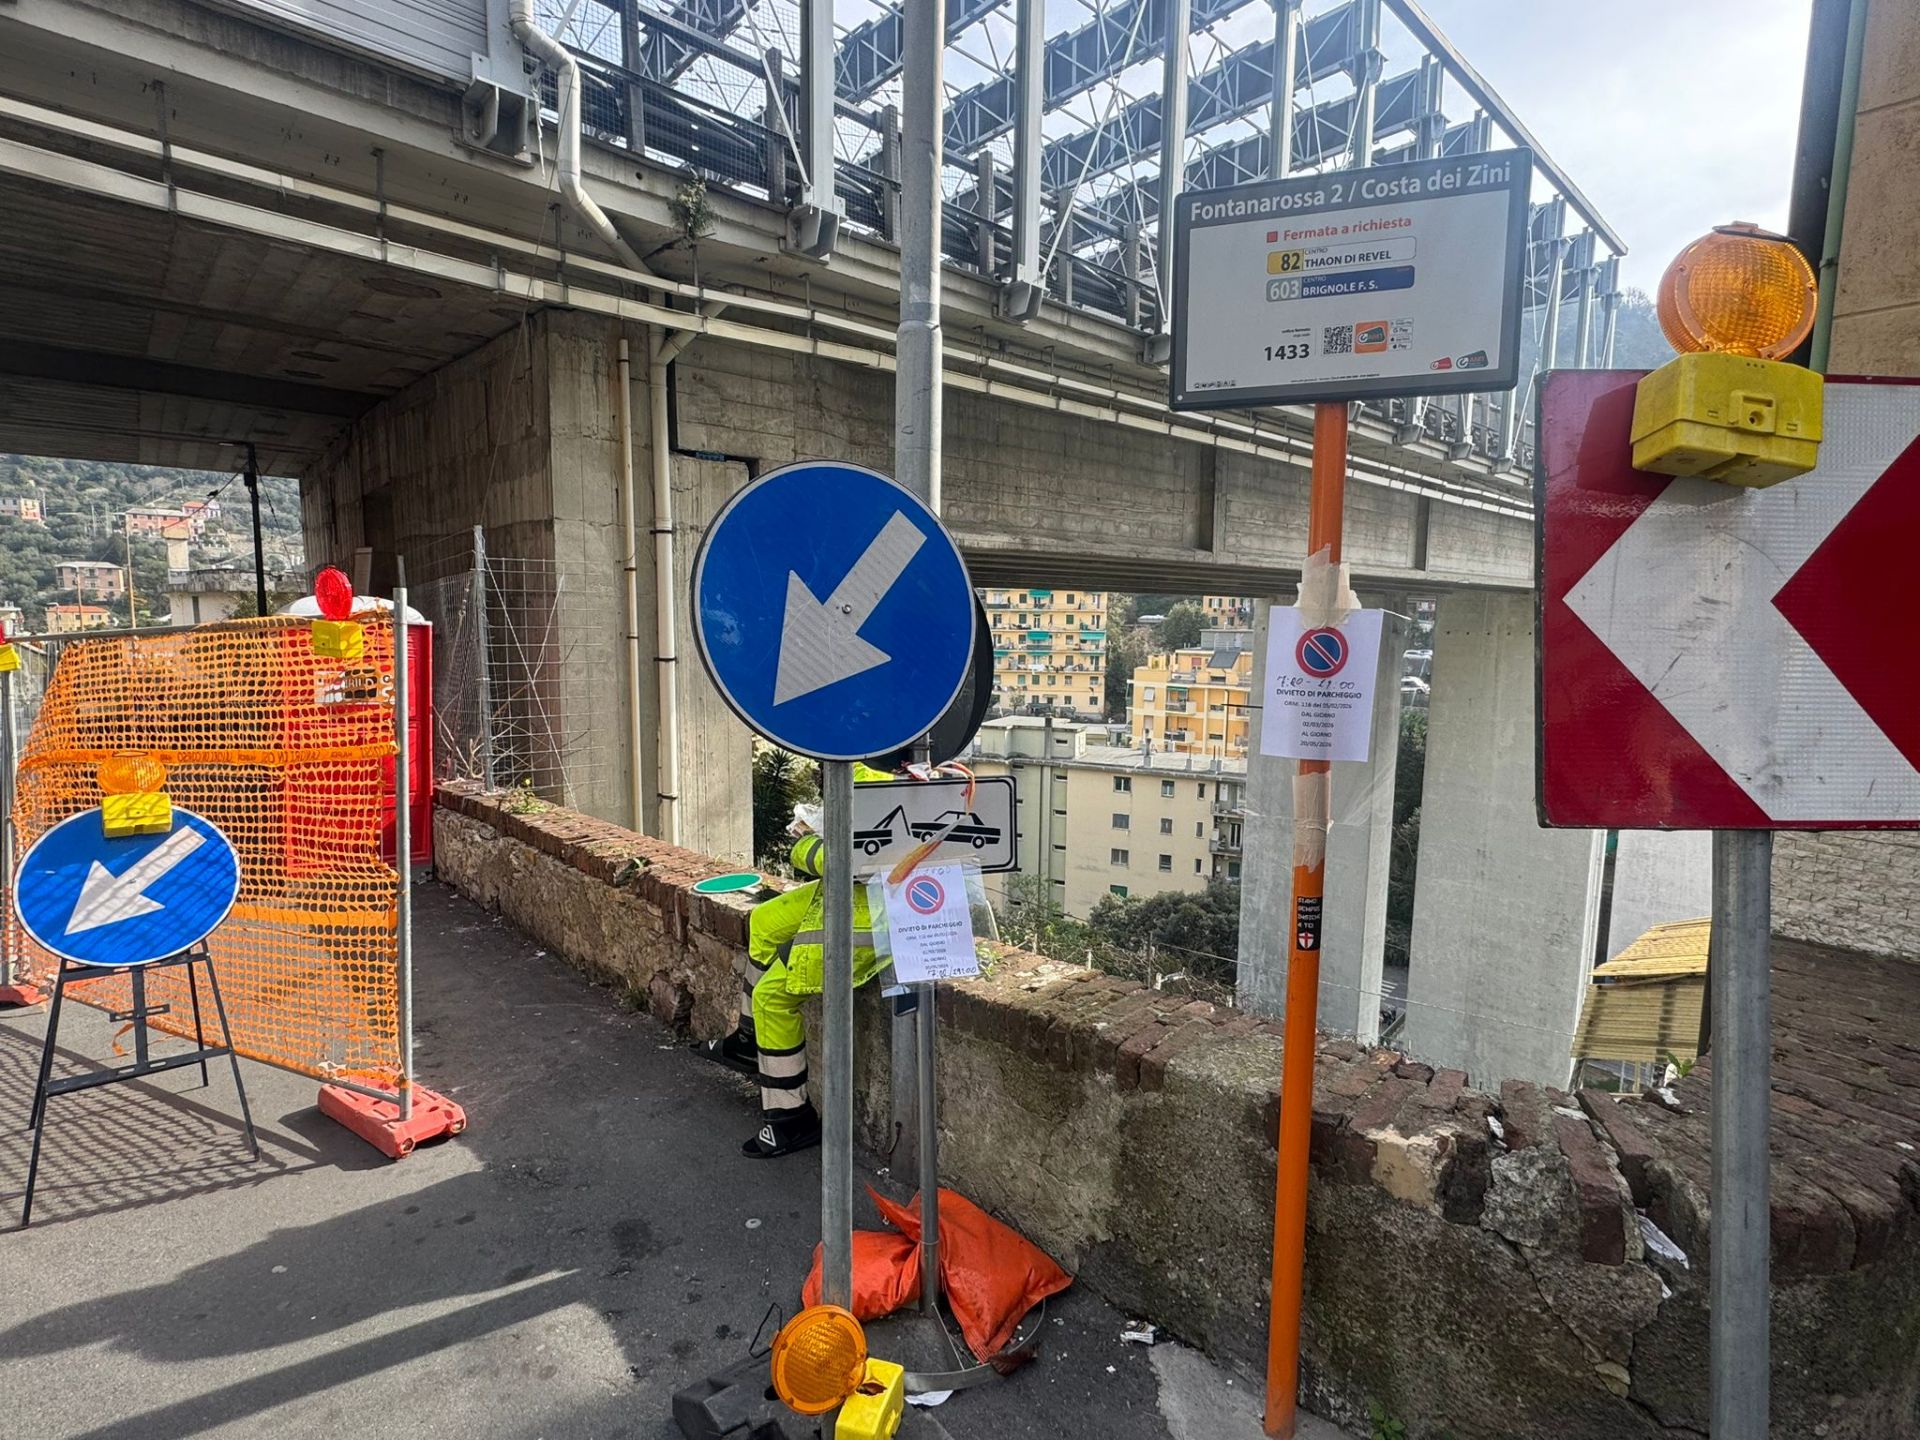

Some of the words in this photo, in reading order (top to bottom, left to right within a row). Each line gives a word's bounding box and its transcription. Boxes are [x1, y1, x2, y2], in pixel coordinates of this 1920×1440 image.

[1191, 190, 1325, 221] Fontanarossa
[1330, 184, 1343, 204] 2
[1348, 181, 1357, 203] /
[1361, 176, 1421, 200] Costa
[1427, 168, 1461, 191] dei
[1466, 161, 1511, 187] Zini
[1283, 226, 1338, 241] Fermata
[1341, 225, 1349, 235] a
[1352, 217, 1412, 233] richiesta
[1304, 247, 1328, 255] CENTRO
[1305, 255, 1342, 268] THAON
[1344, 254, 1356, 264] DI
[1358, 250, 1391, 262] REVEL
[1281, 252, 1300, 271] 82
[1270, 281, 1299, 300] 603
[1302, 282, 1356, 297] BRIGNOLE
[1358, 281, 1366, 291] F.
[1368, 280, 1379, 290] S.
[1264, 343, 1310, 361] 1433
[1276, 688, 1306, 697] DIVIETO
[1317, 691, 1362, 699] PARCHEGGIO
[898, 925, 920, 933] DIVIETO
[928, 920, 963, 930] PARCHEGGIO
